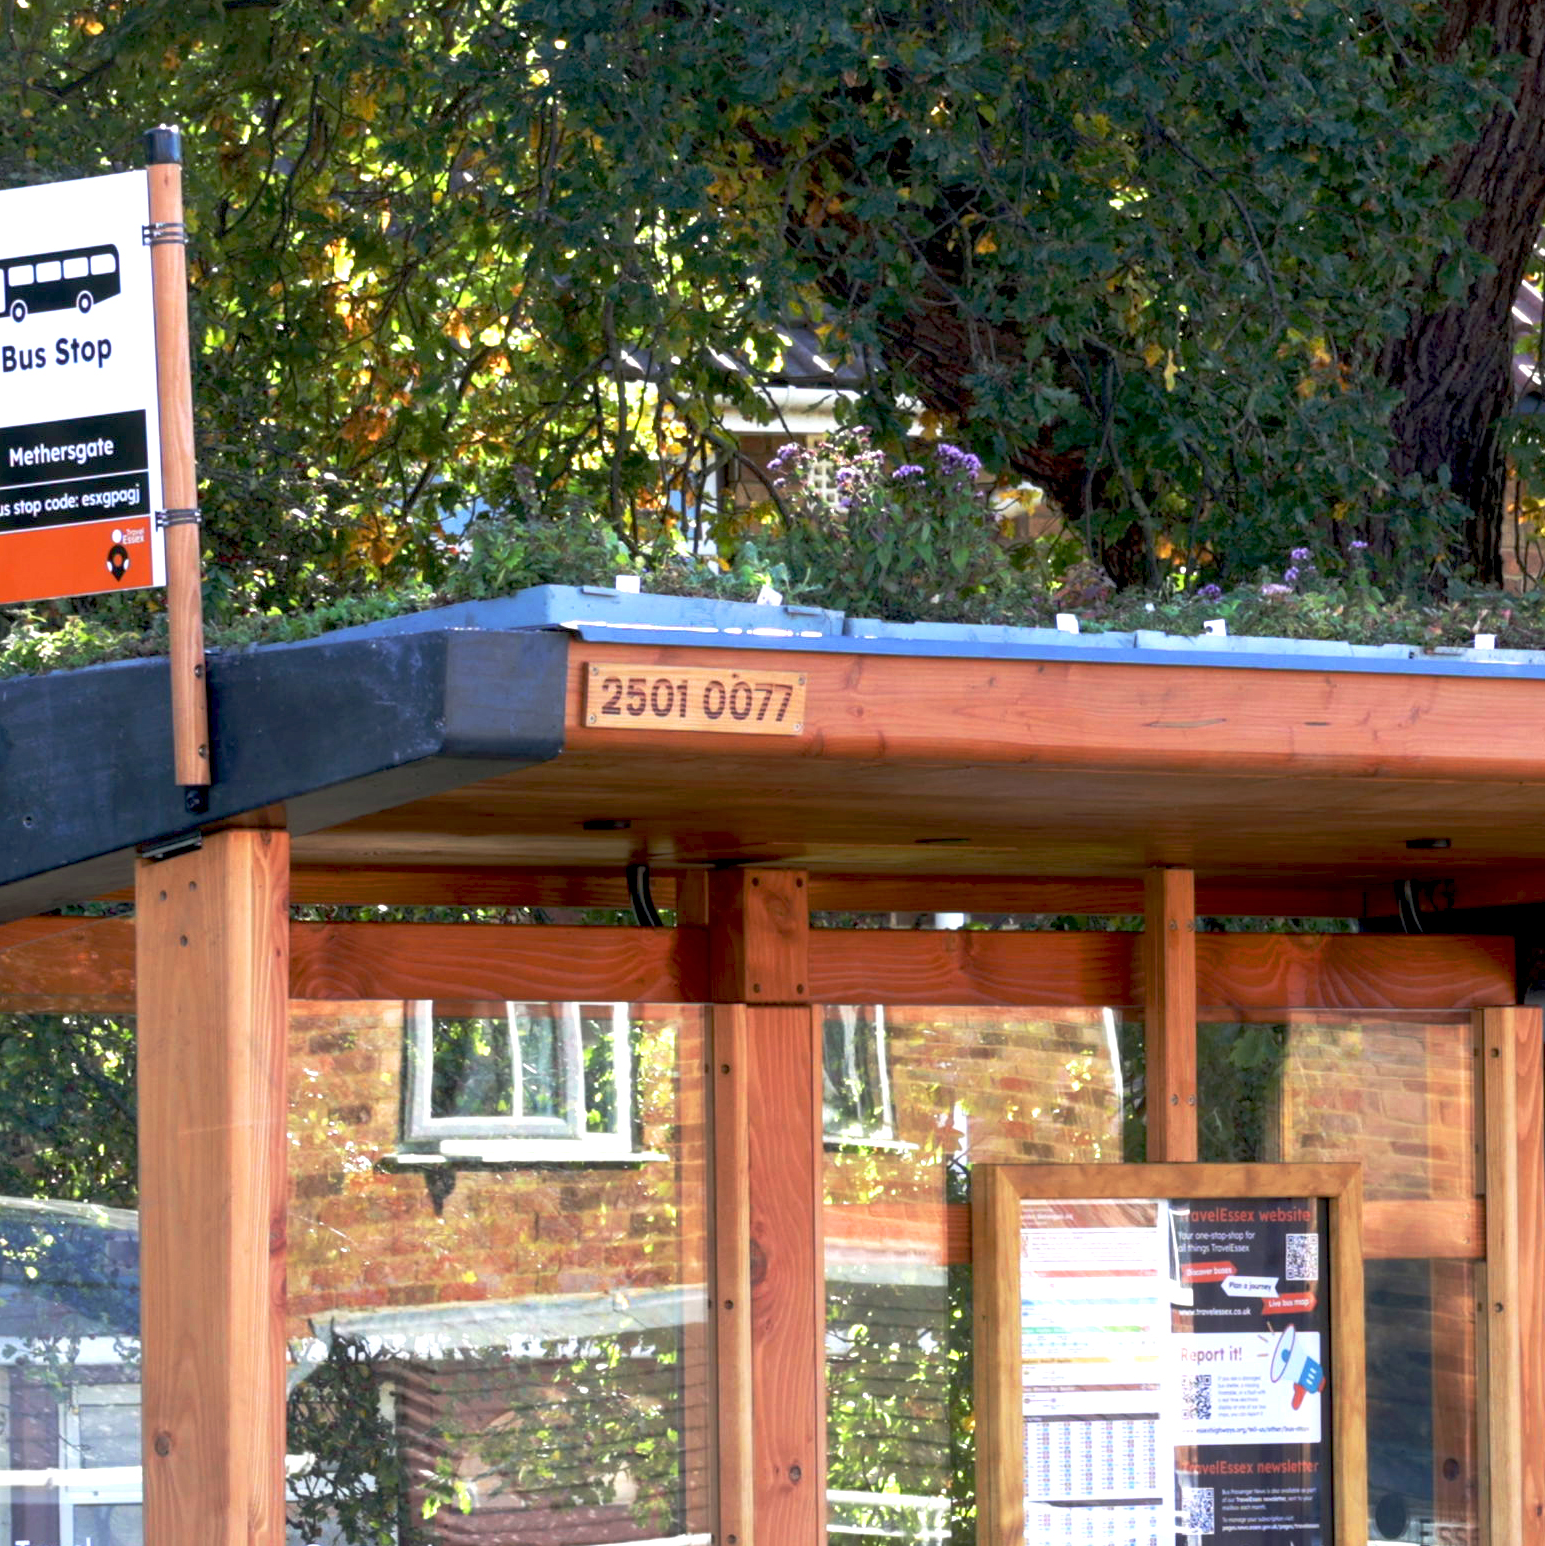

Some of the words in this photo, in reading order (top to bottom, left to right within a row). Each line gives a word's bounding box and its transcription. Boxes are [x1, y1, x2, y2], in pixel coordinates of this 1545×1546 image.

[2, 345, 46, 372] Bus
[55, 338, 112, 368] Stop
[9, 438, 114, 467] Methersgate
[13, 500, 42, 517] stop
[45, 493, 79, 512] code:
[81, 483, 141, 508] esxgpagj
[123, 534, 145, 545] Essex
[601, 677, 688, 718] 2501
[703, 680, 794, 722] 0077
[1259, 1206, 1311, 1222] website
[1245, 1230, 1256, 1239] for
[1187, 1244, 1210, 1254] things
[1212, 1243, 1250, 1252] TravelEssex
[1228, 1281, 1242, 1289] Plan
[1249, 1281, 1272, 1292] journey
[1269, 1300, 1281, 1308] Live
[1181, 1347, 1224, 1365] Report
[1229, 1345, 1242, 1361] it!
[1182, 1460, 1253, 1475] TravelEssex
[1257, 1459, 1319, 1474] newsletter
